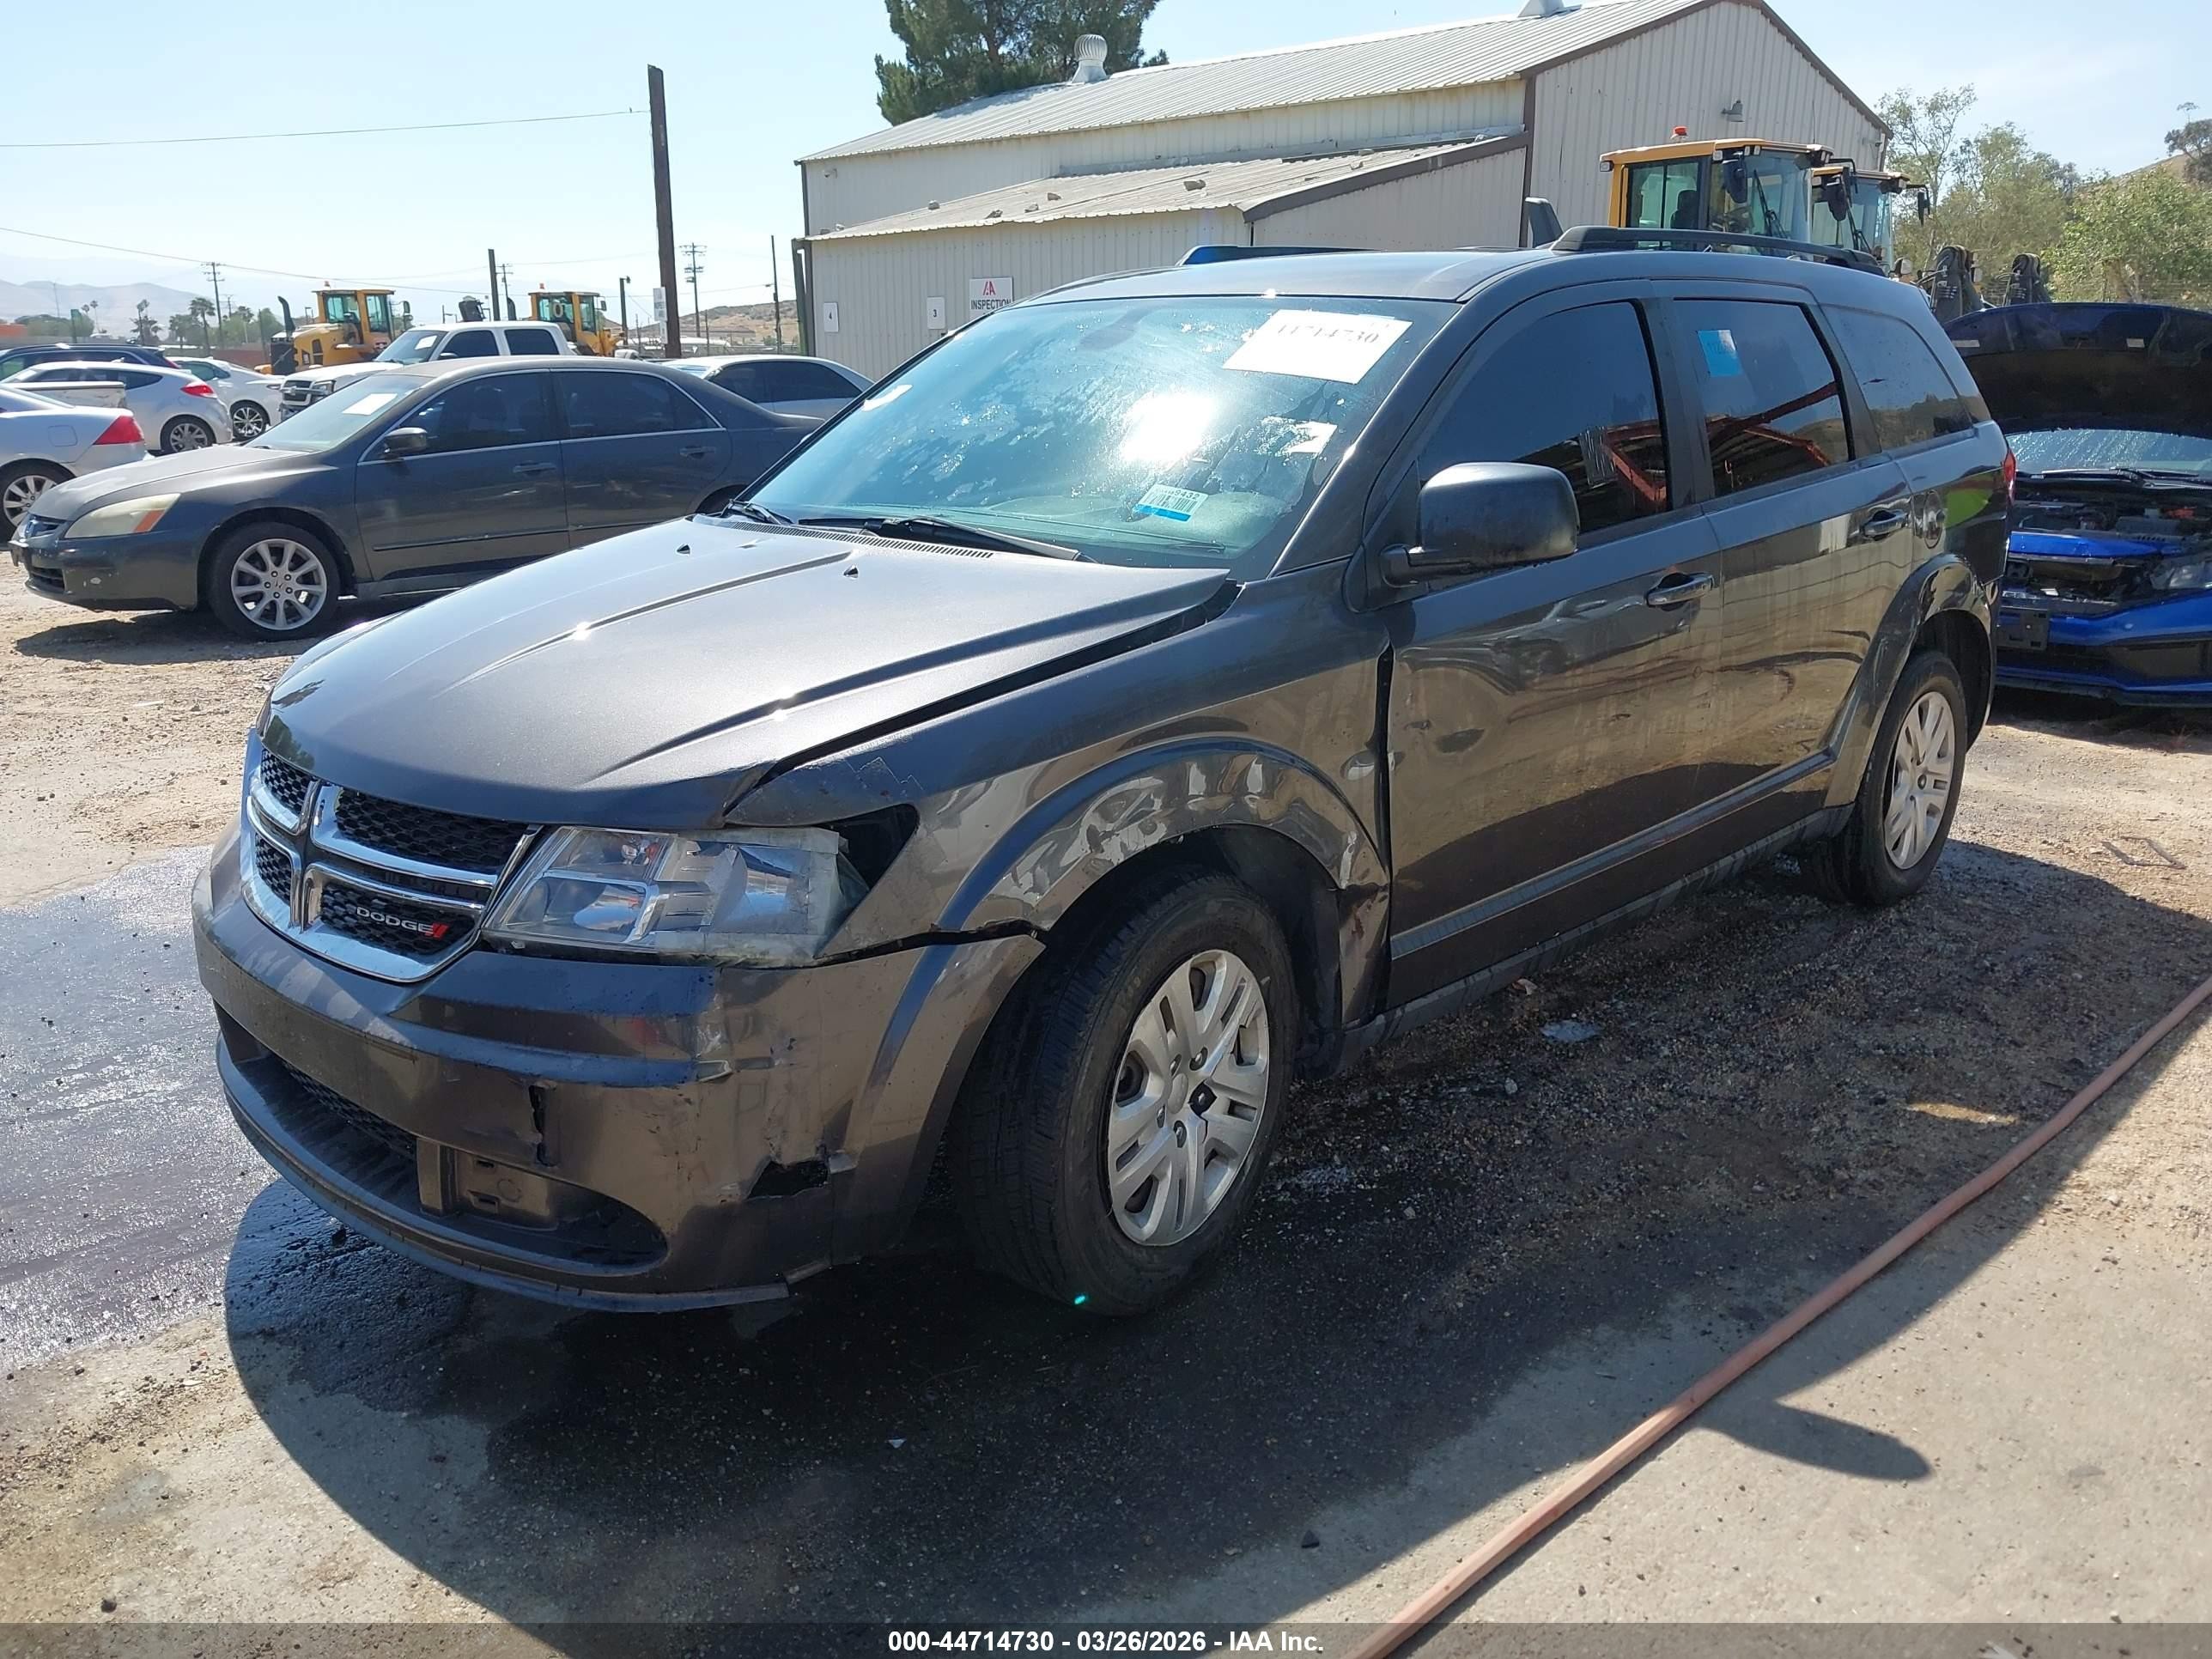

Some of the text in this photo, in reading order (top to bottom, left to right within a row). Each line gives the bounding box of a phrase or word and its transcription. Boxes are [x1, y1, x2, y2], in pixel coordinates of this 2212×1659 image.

[828, 312, 833, 320] 4
[933, 309, 938, 318] 3
[356, 906, 434, 935] DODGE
